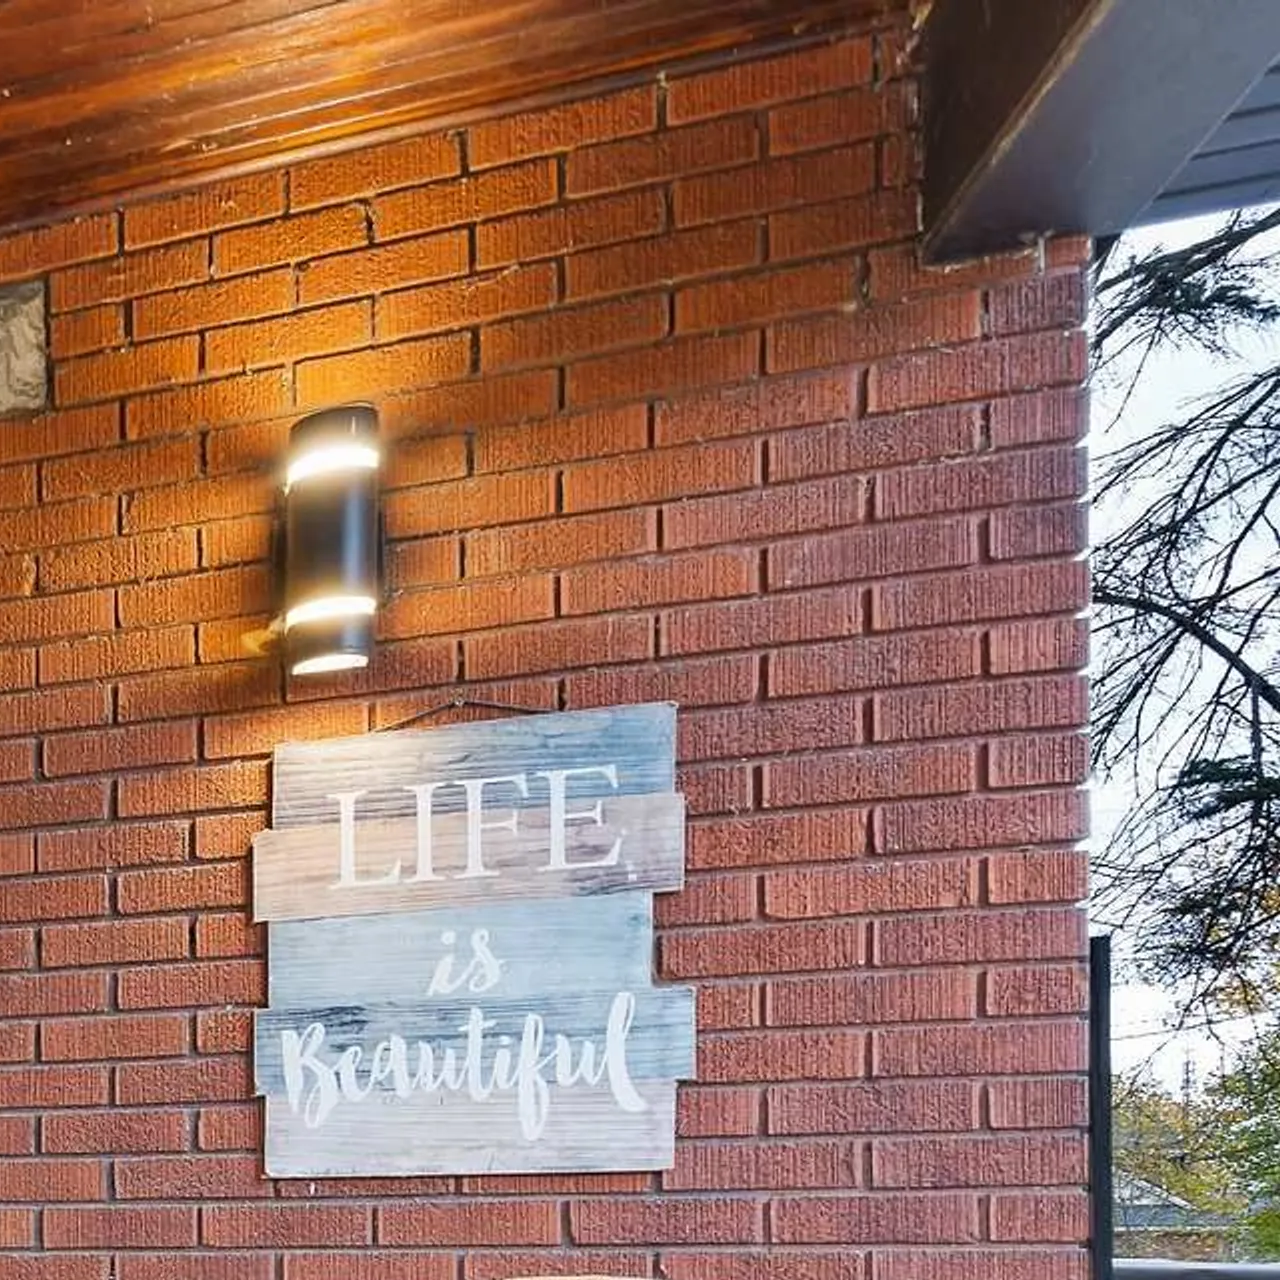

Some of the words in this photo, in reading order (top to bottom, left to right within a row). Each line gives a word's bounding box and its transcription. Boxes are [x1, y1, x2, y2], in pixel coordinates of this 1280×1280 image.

[326, 764, 624, 890] LIFE
[427, 928, 503, 997] is
[280, 991, 650, 1142] Beautiful
